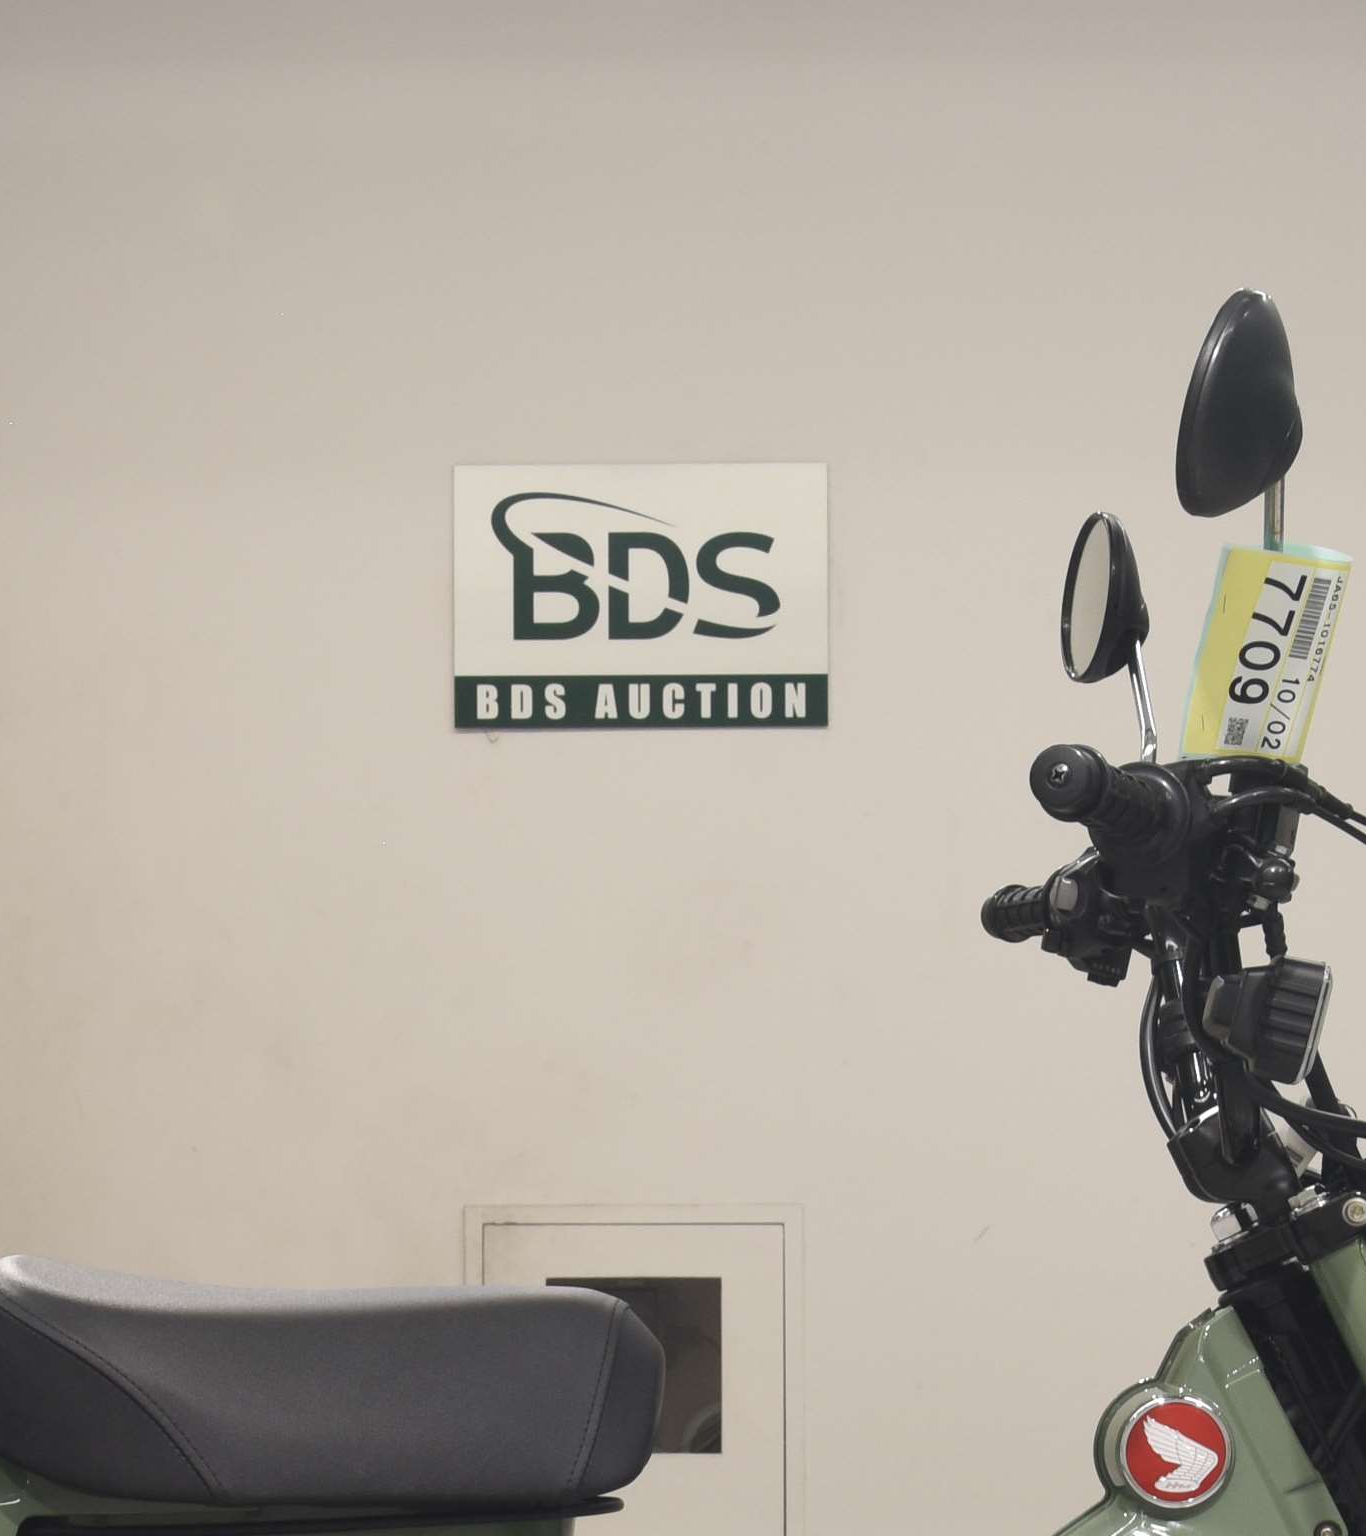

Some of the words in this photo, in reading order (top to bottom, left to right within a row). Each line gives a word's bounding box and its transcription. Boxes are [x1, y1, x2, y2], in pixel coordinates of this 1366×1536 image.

[491, 492, 780, 640] BDS
[1228, 575, 1307, 704] 7709
[476, 683, 566, 720] BDS
[595, 682, 806, 719] AUCTION
[1261, 677, 1300, 749] 10/02
